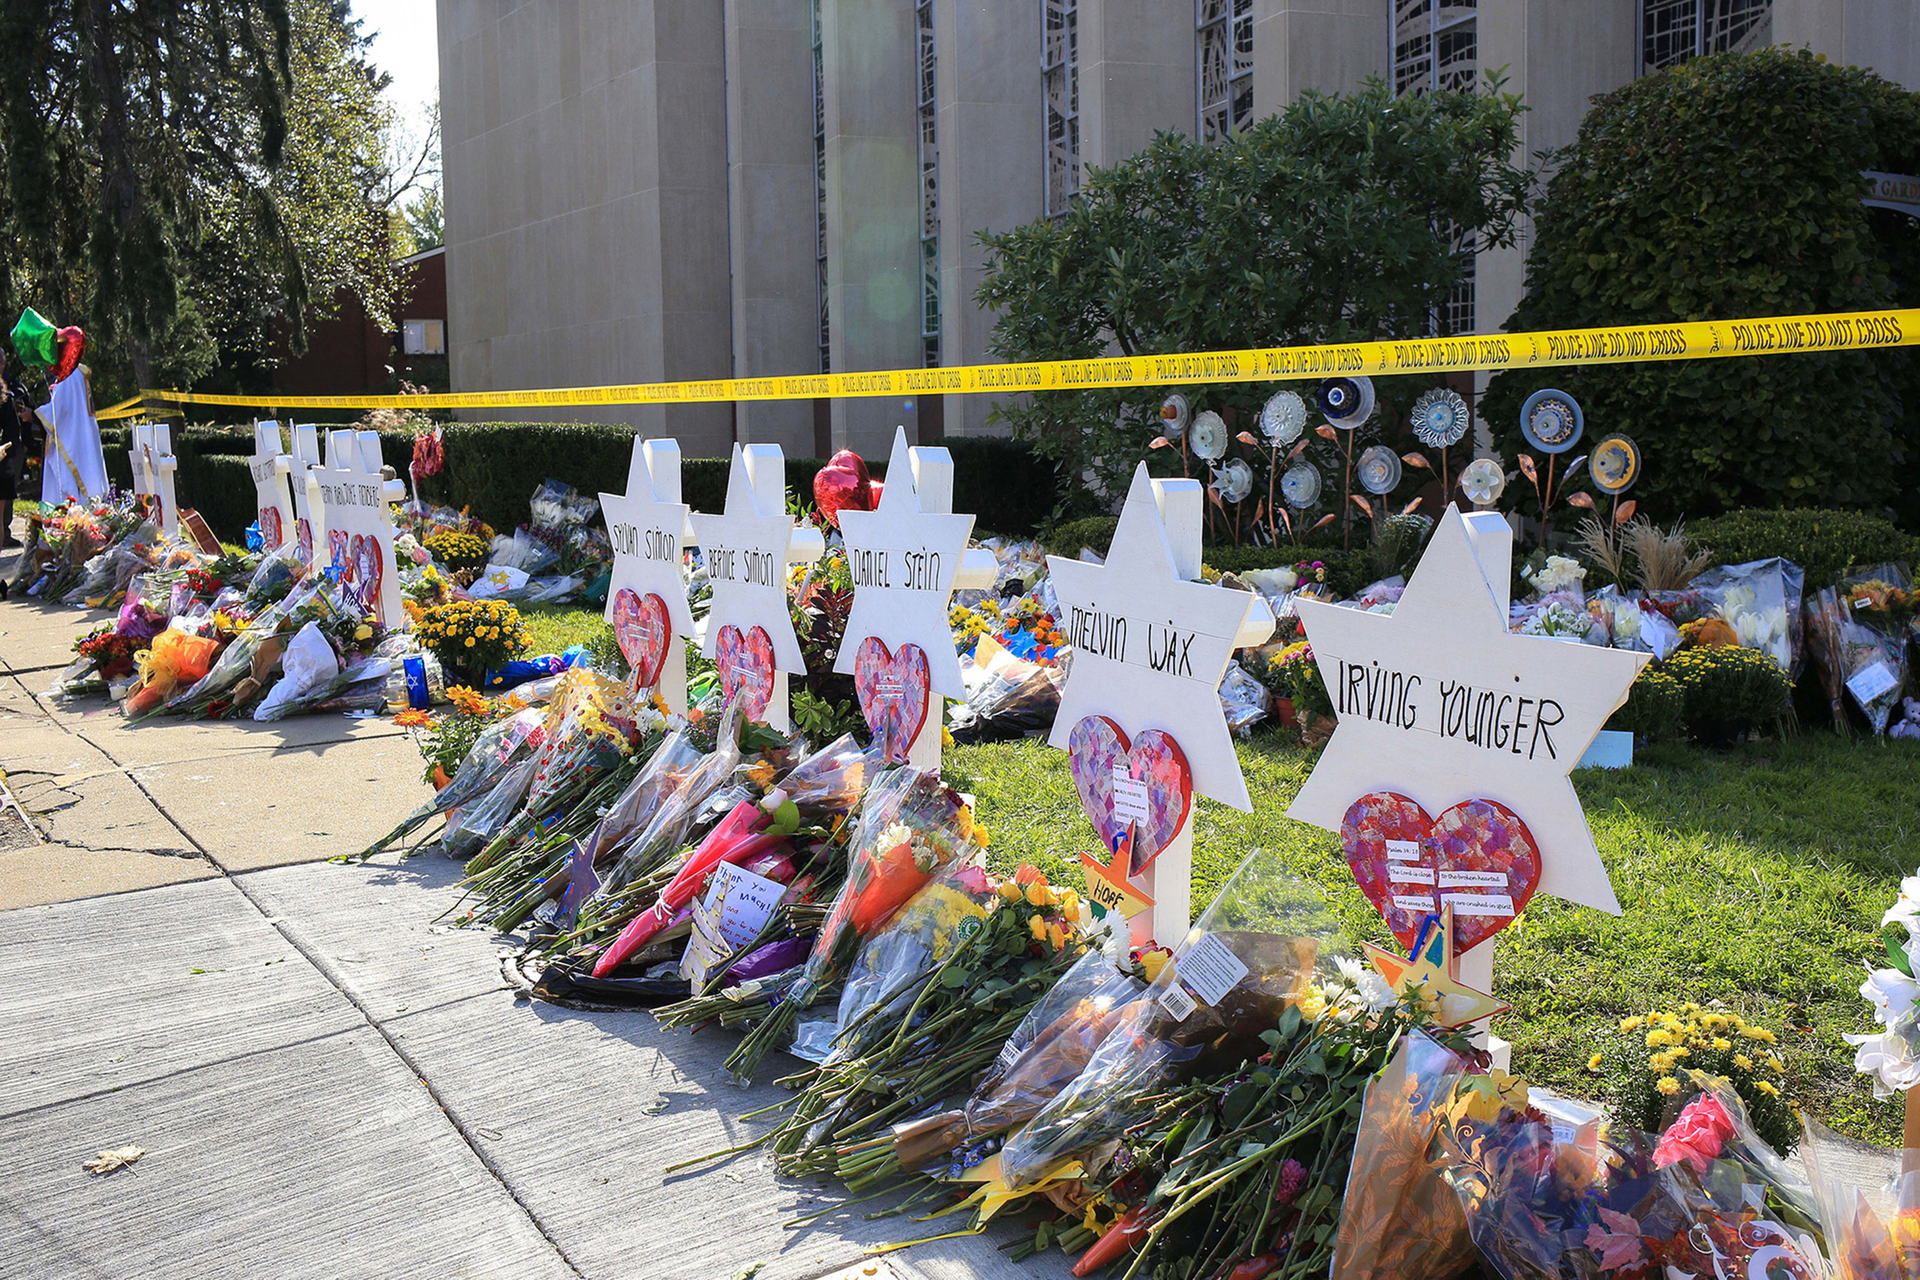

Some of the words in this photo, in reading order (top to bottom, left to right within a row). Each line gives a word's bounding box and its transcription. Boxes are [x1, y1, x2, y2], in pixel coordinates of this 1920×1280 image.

[1547, 335, 1582, 360] POLICE
[1582, 333, 1607, 358] LINE
[1608, 332, 1624, 357] DO
[1626, 330, 1647, 356] NOT
[1649, 328, 1687, 355] CROSS
[1732, 324, 1774, 350] POLICE
[1775, 322, 1804, 349] LINE
[1805, 321, 1826, 347] DO
[1828, 319, 1853, 346] NOT
[1856, 316, 1902, 344] CROSS
[1155, 358, 1177, 379] POLICE
[1178, 358, 1192, 379] LINE
[1192, 357, 1202, 378] DO
[1203, 356, 1215, 377] NOT
[1216, 355, 1239, 376] CROSS
[1266, 352, 1290, 374] POLICE
[1291, 352, 1308, 374] LINE
[1309, 351, 1319, 373] DO
[1320, 350, 1335, 372] NOT
[1337, 348, 1364, 371] CROSS
[1395, 345, 1422, 368] POLICE
[1425, 344, 1444, 367] LINE
[1445, 343, 1458, 366] DO
[1460, 342, 1477, 365] NOT
[1479, 339, 1510, 364] CROSS
[1061, 364, 1079, 383] POLICE
[1080, 364, 1092, 382] LINE
[1092, 363, 1100, 382] DO
[1101, 362, 1112, 382] NOT
[1113, 361, 1132, 381] CROSS
[1148, 623, 1195, 677] WAX
[1094, 879, 1124, 910] HOPE
